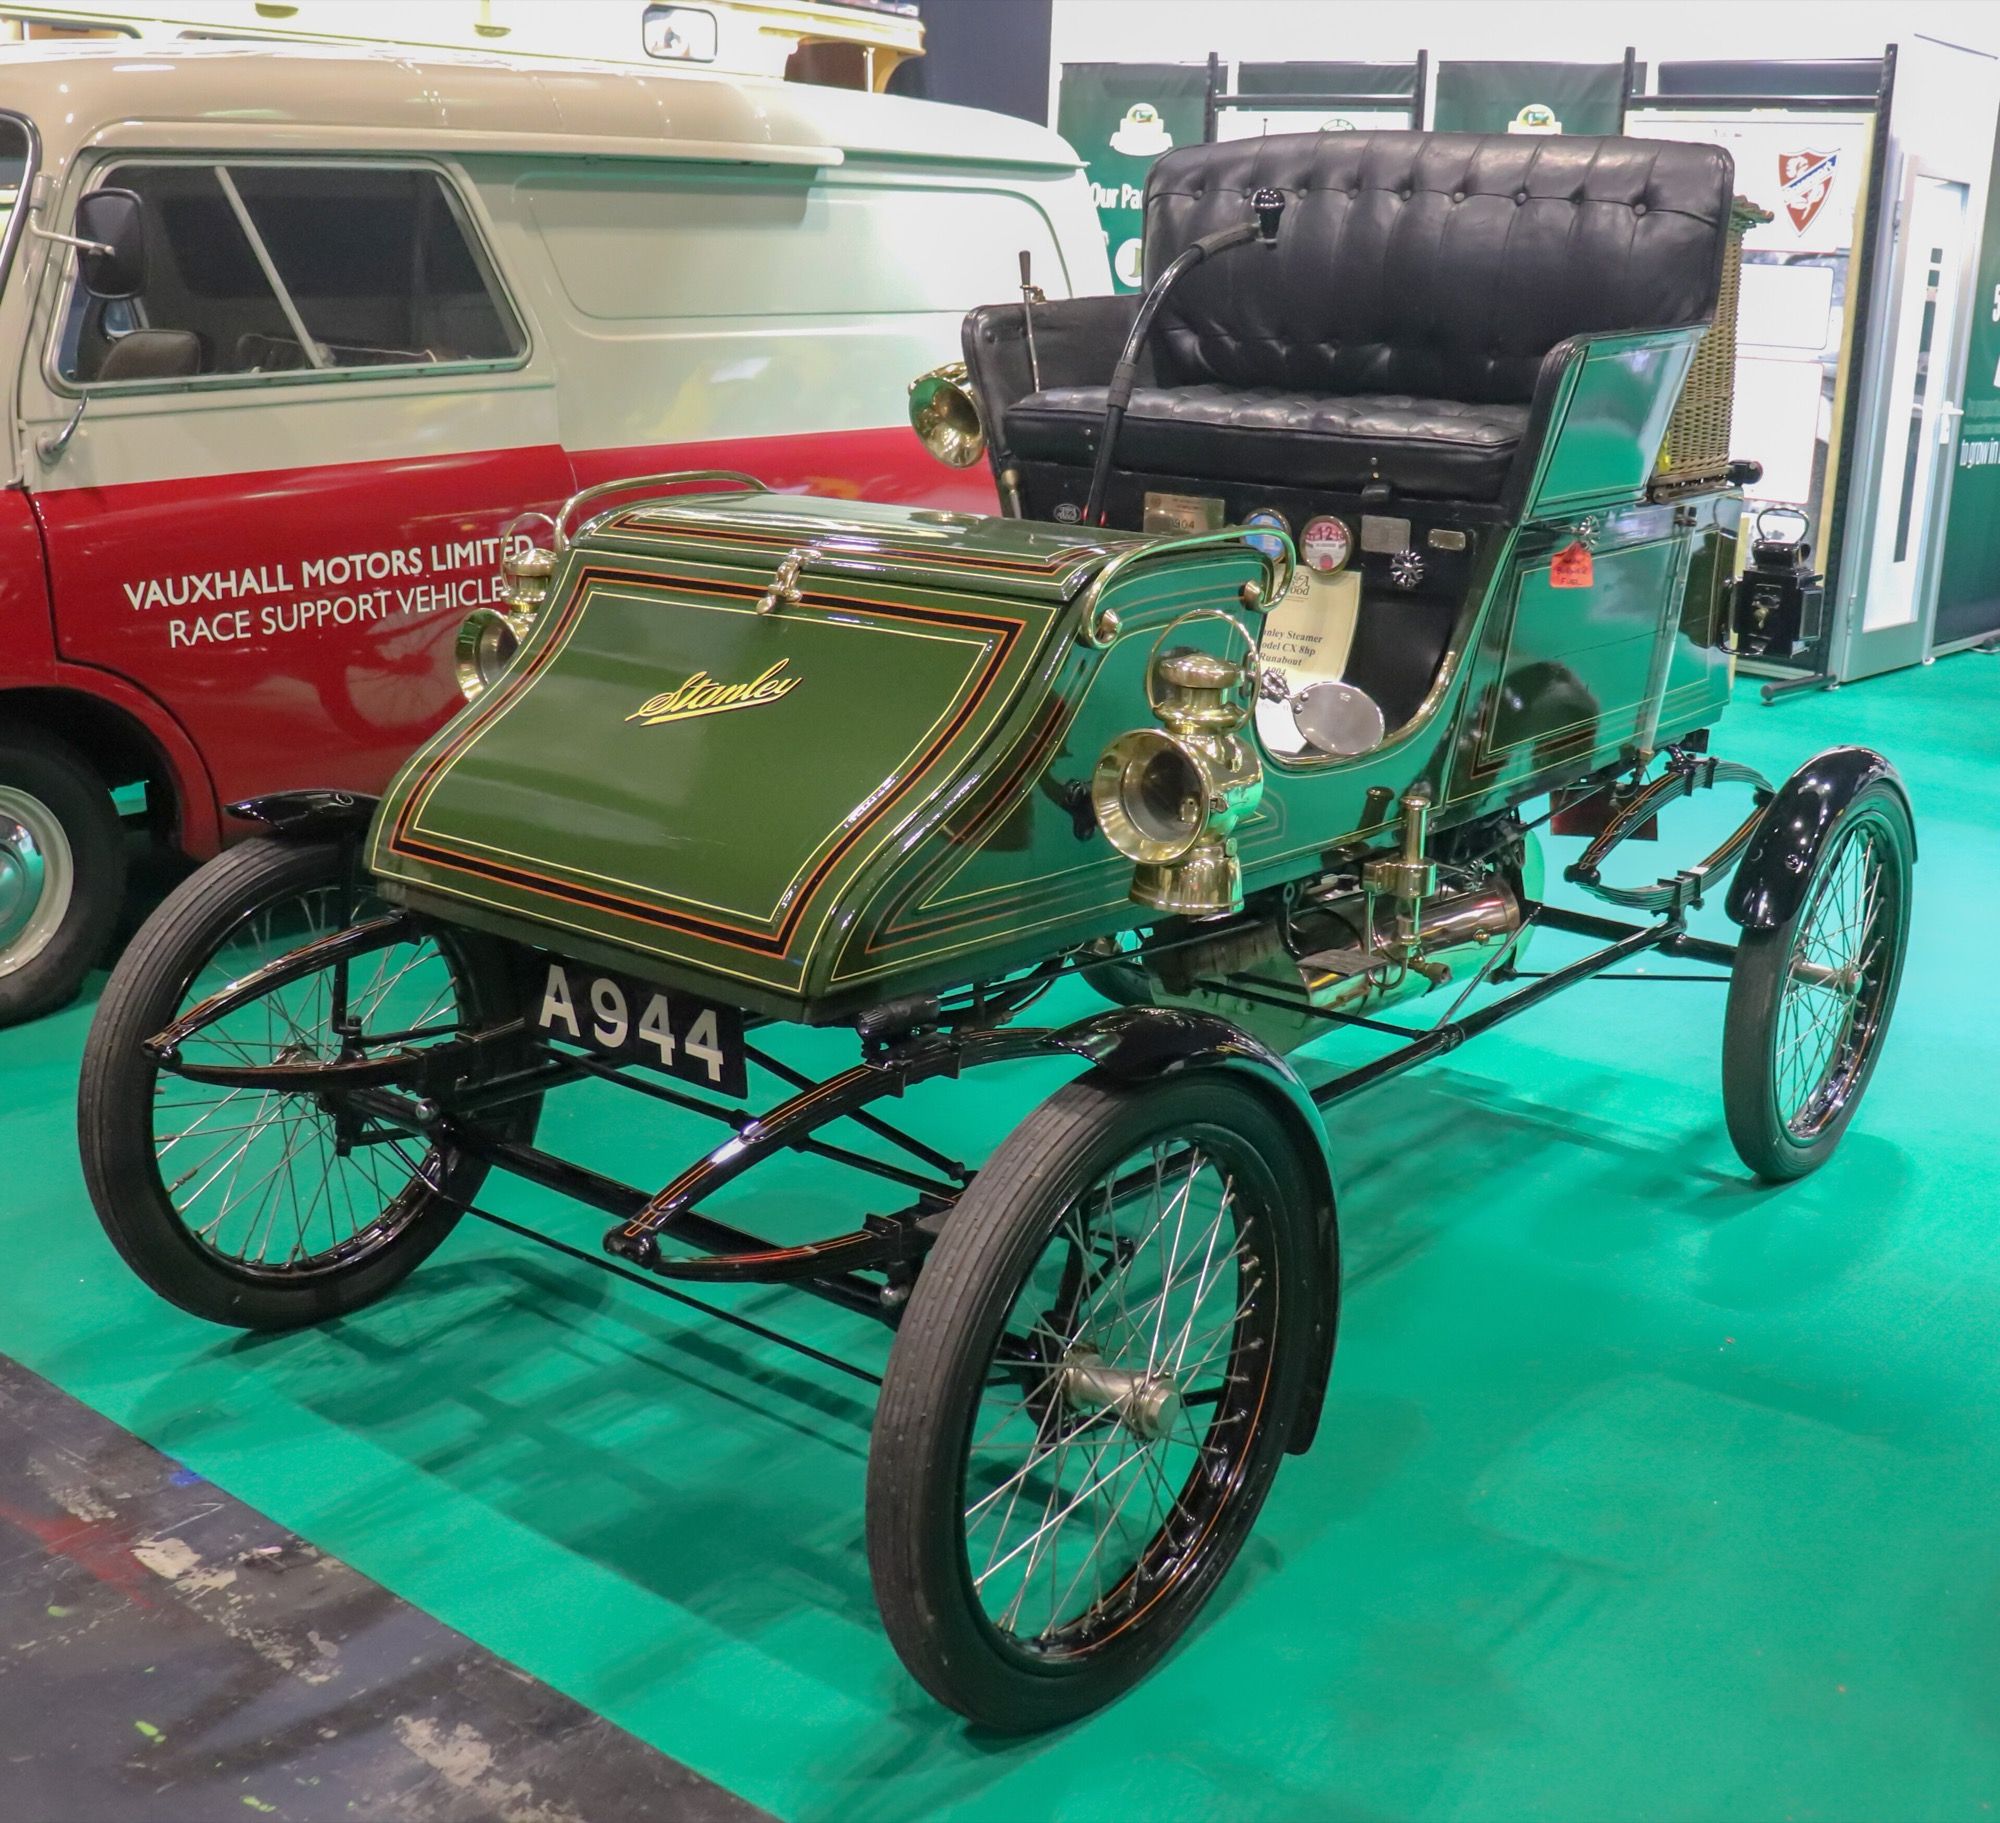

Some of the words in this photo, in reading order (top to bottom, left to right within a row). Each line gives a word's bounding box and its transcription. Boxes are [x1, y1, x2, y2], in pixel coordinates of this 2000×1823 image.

[1090, 182, 1119, 209] Our
[123, 564, 294, 611] VAUXHALL
[301, 547, 423, 589] MOTORS
[431, 534, 534, 572] LIMITED
[169, 609, 252, 649] RACE
[261, 589, 392, 635] SUPPORT
[396, 576, 505, 614] VEHICLE
[1259, 652, 1302, 666] Runabout
[1261, 642, 1280, 650] odel
[1282, 643, 1297, 653] CX
[1299, 645, 1316, 658] 8hp
[1287, 630, 1323, 643] Steamer
[624, 658, 802, 726] Stanley
[539, 963, 724, 1082] A944
